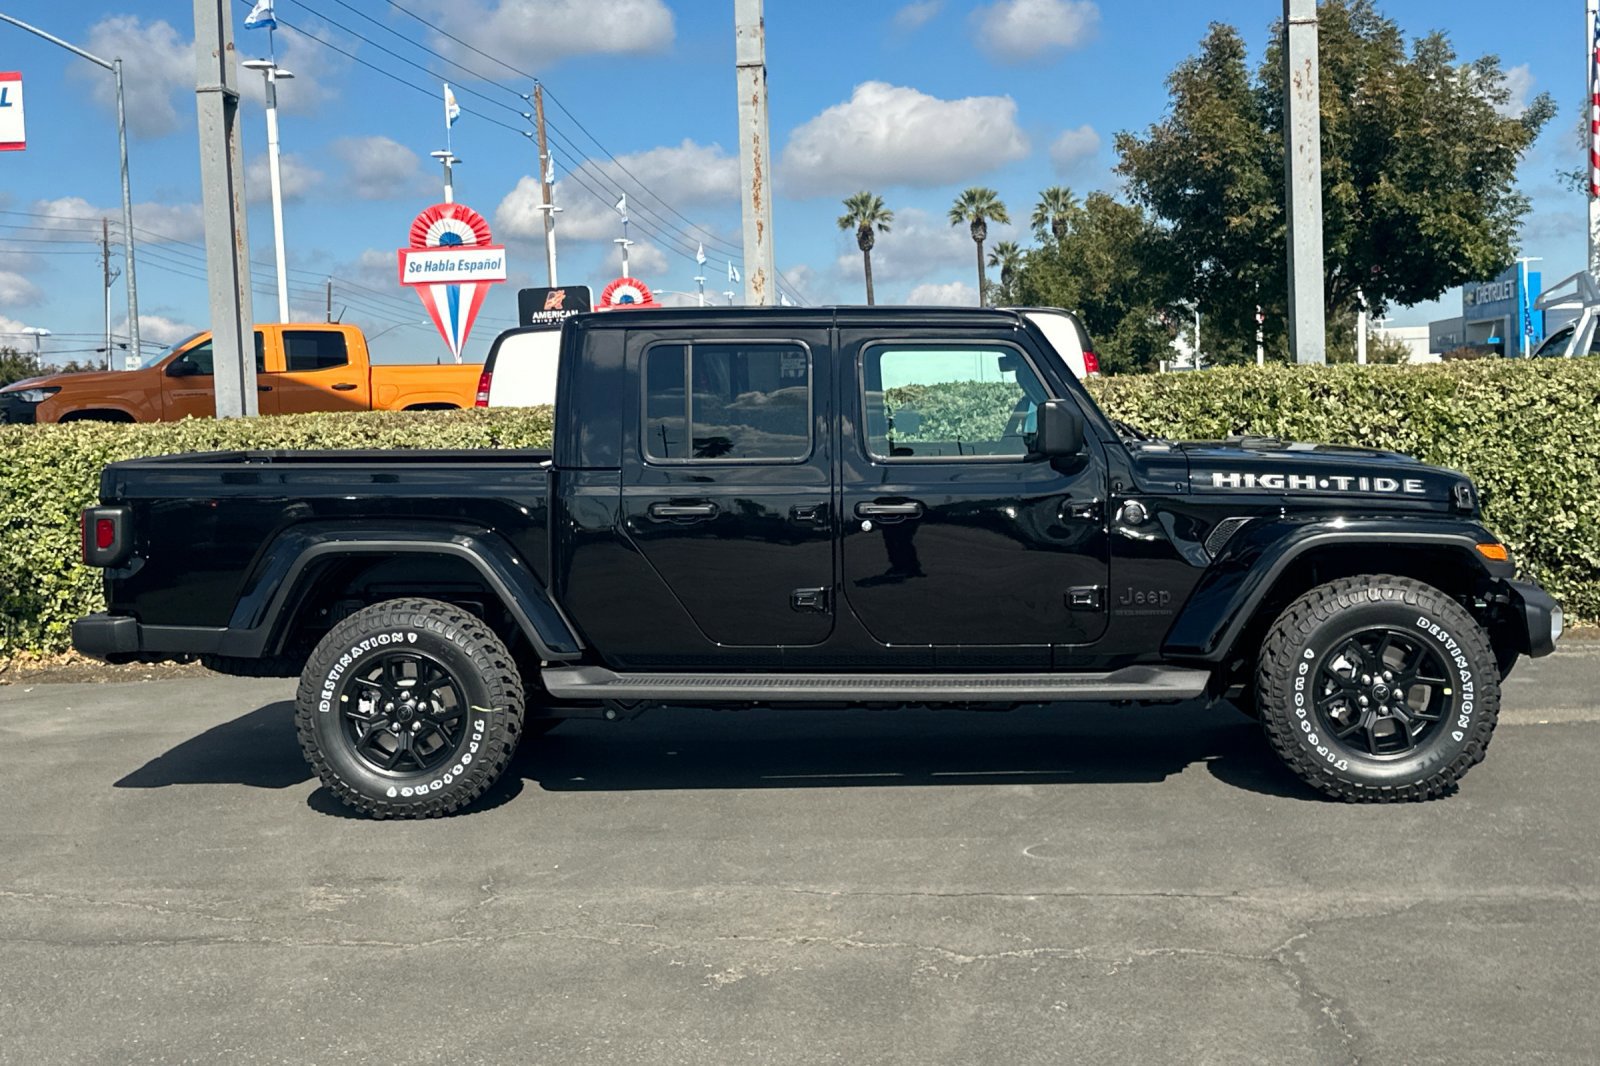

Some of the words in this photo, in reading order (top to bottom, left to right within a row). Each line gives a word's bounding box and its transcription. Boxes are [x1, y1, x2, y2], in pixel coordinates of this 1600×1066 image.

[408, 261, 422, 273] Se
[424, 259, 455, 272] Habla
[457, 258, 502, 273] Español
[1475, 280, 1517, 305] CHEVROLET
[532, 309, 579, 320] AMERICAN
[1119, 587, 1172, 607] Jeep
[319, 632, 404, 712] DESTINATION
[1416, 616, 1474, 729] DESTINATION
